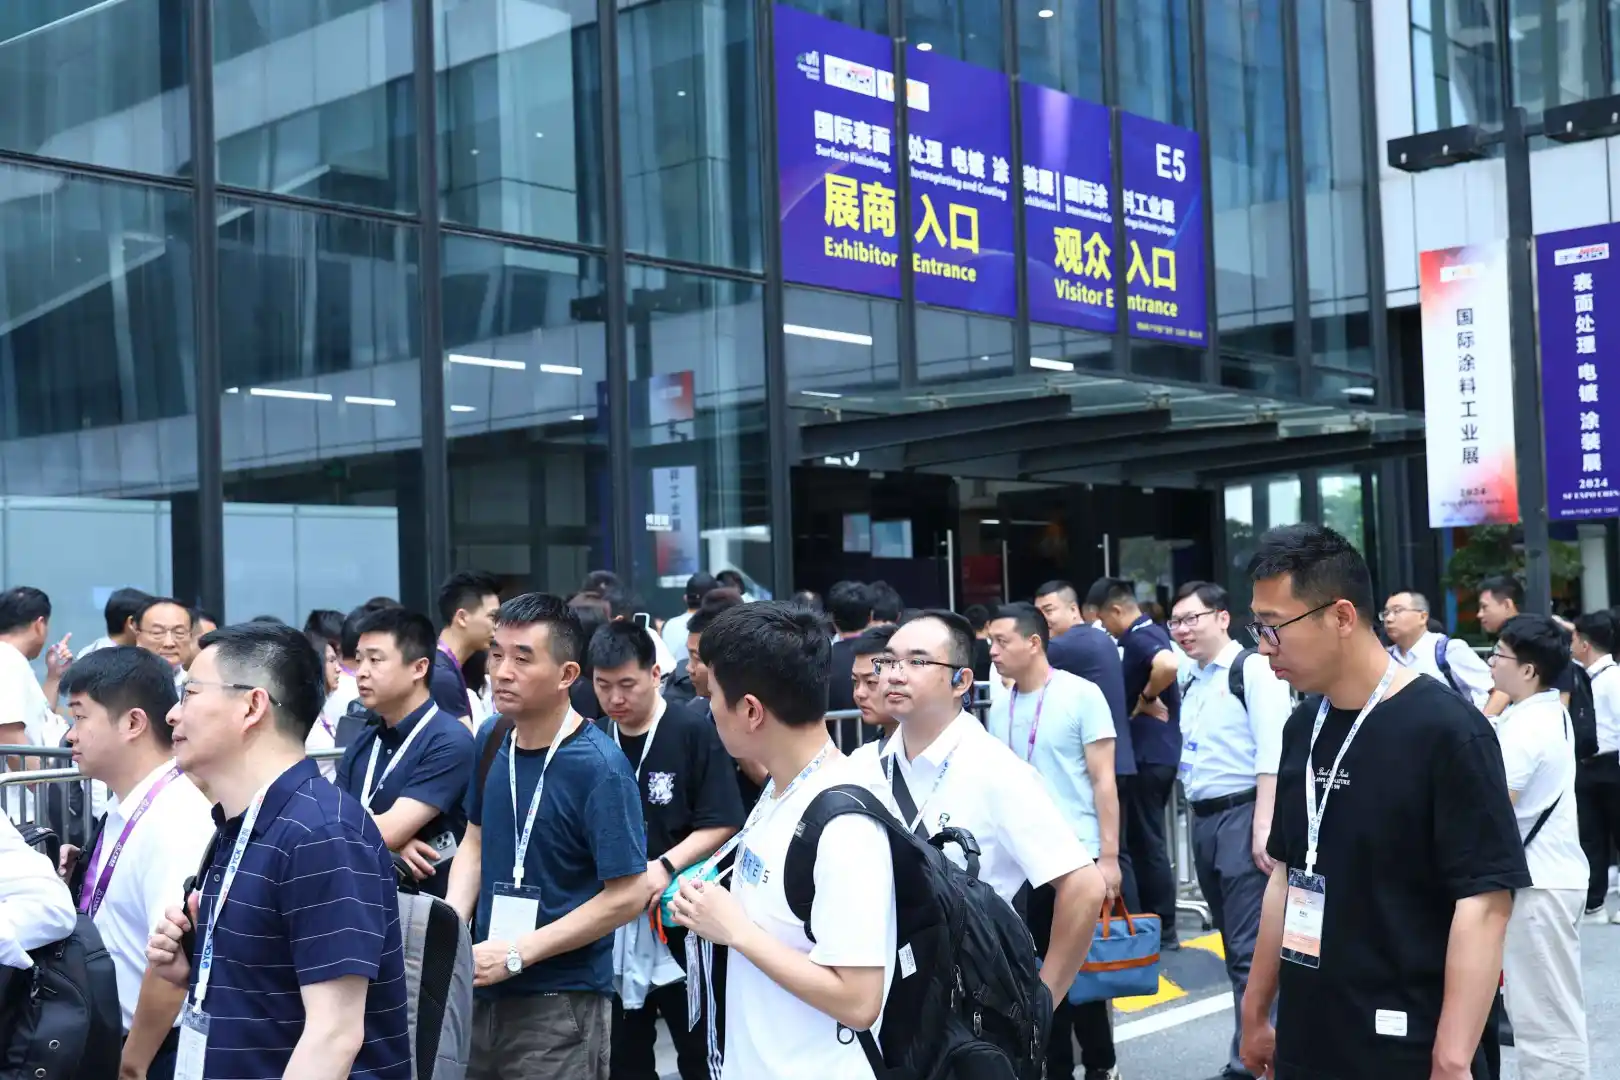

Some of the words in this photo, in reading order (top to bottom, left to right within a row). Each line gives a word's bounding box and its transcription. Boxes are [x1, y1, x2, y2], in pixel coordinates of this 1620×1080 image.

[1154, 143, 1186, 182] E5
[824, 173, 896, 237] 展商
[914, 193, 979, 255] 入口
[824, 236, 898, 268] Exhibitor
[912, 253, 977, 283] Entrance
[1053, 227, 1112, 281] 观众
[1126, 240, 1176, 291] 入口
[1054, 278, 1103, 306] Visitor
[1573, 272, 1596, 354] 表面处理
[1456, 307, 1479, 465] 国际涂料工业展
[1460, 487, 1487, 498] 2024
[1579, 477, 1609, 490] 2024
[231, 849, 243, 866] YCK
[202, 943, 213, 961] YCK
